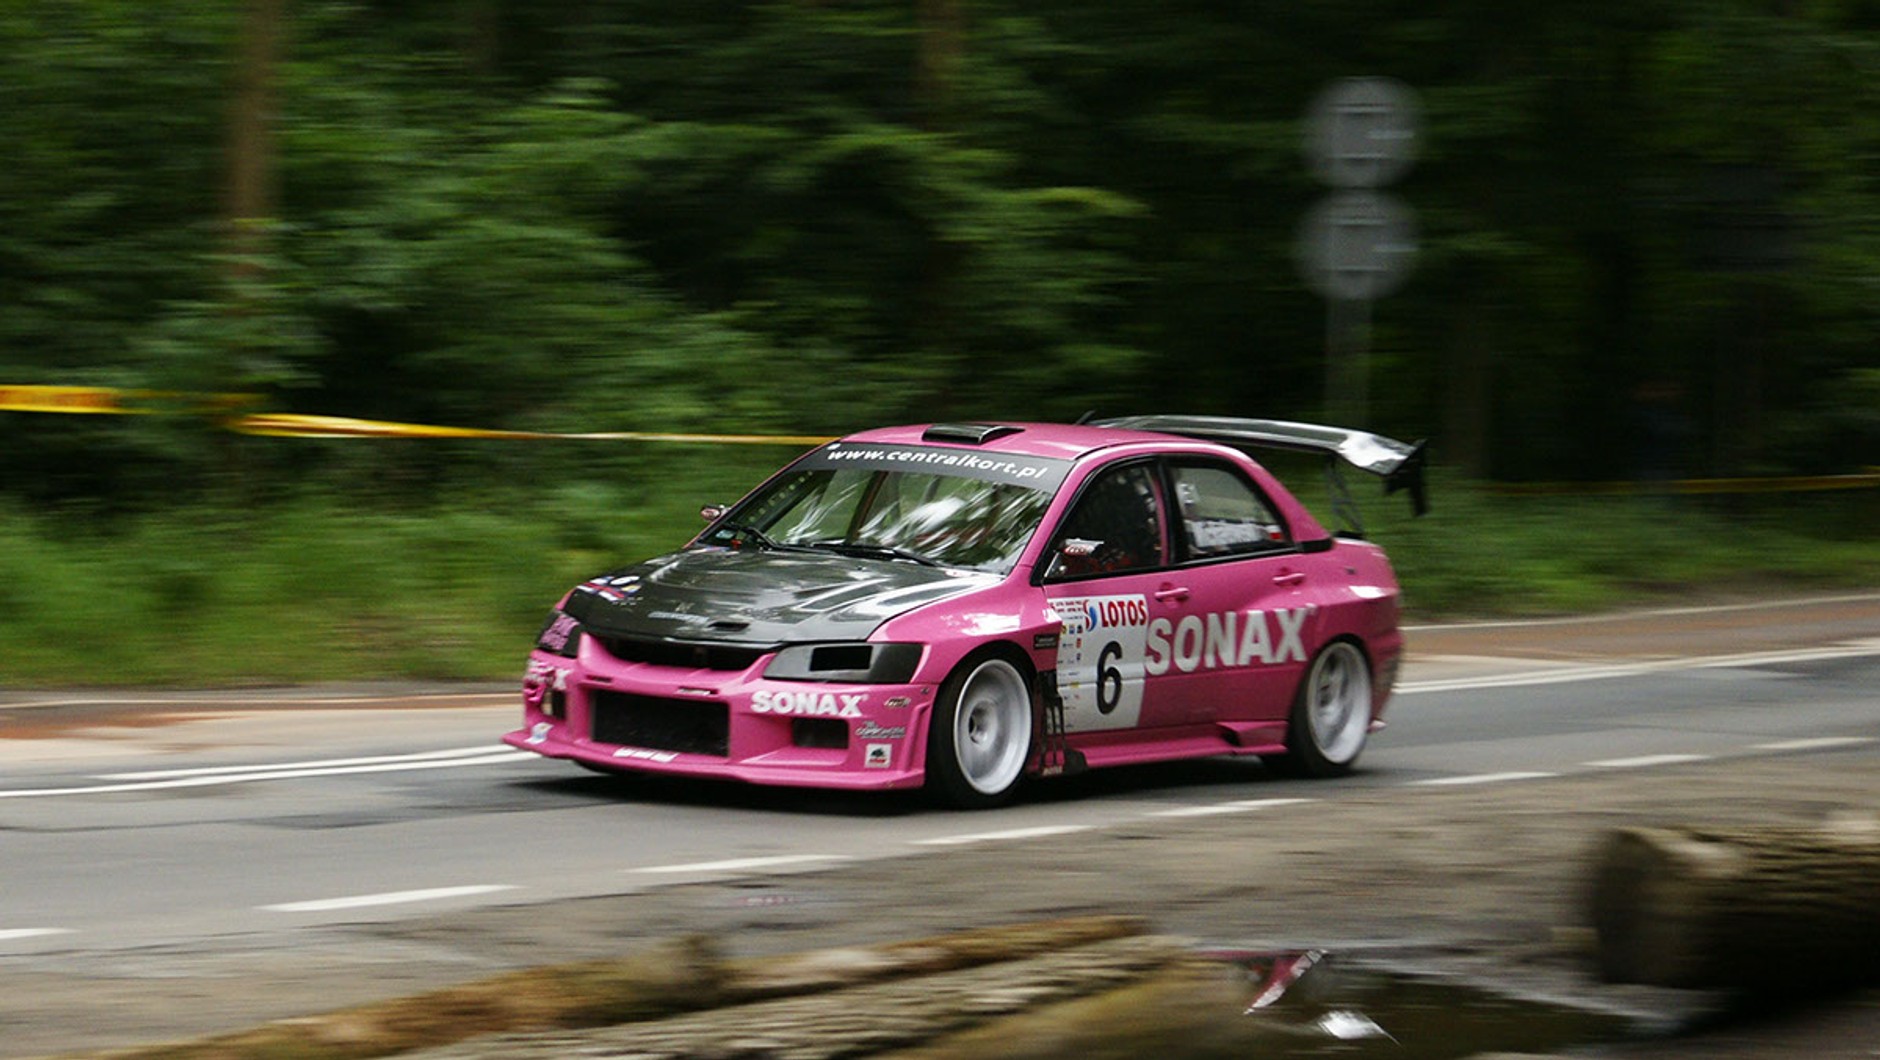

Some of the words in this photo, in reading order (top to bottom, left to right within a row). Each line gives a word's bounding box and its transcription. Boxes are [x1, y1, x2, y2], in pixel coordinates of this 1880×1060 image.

[828, 450, 1047, 479] www.centralkort.pl
[1099, 600, 1147, 627] LOTOS
[1145, 608, 1308, 675] SONAX
[1097, 641, 1122, 715] 6
[751, 690, 863, 717] SONAX
